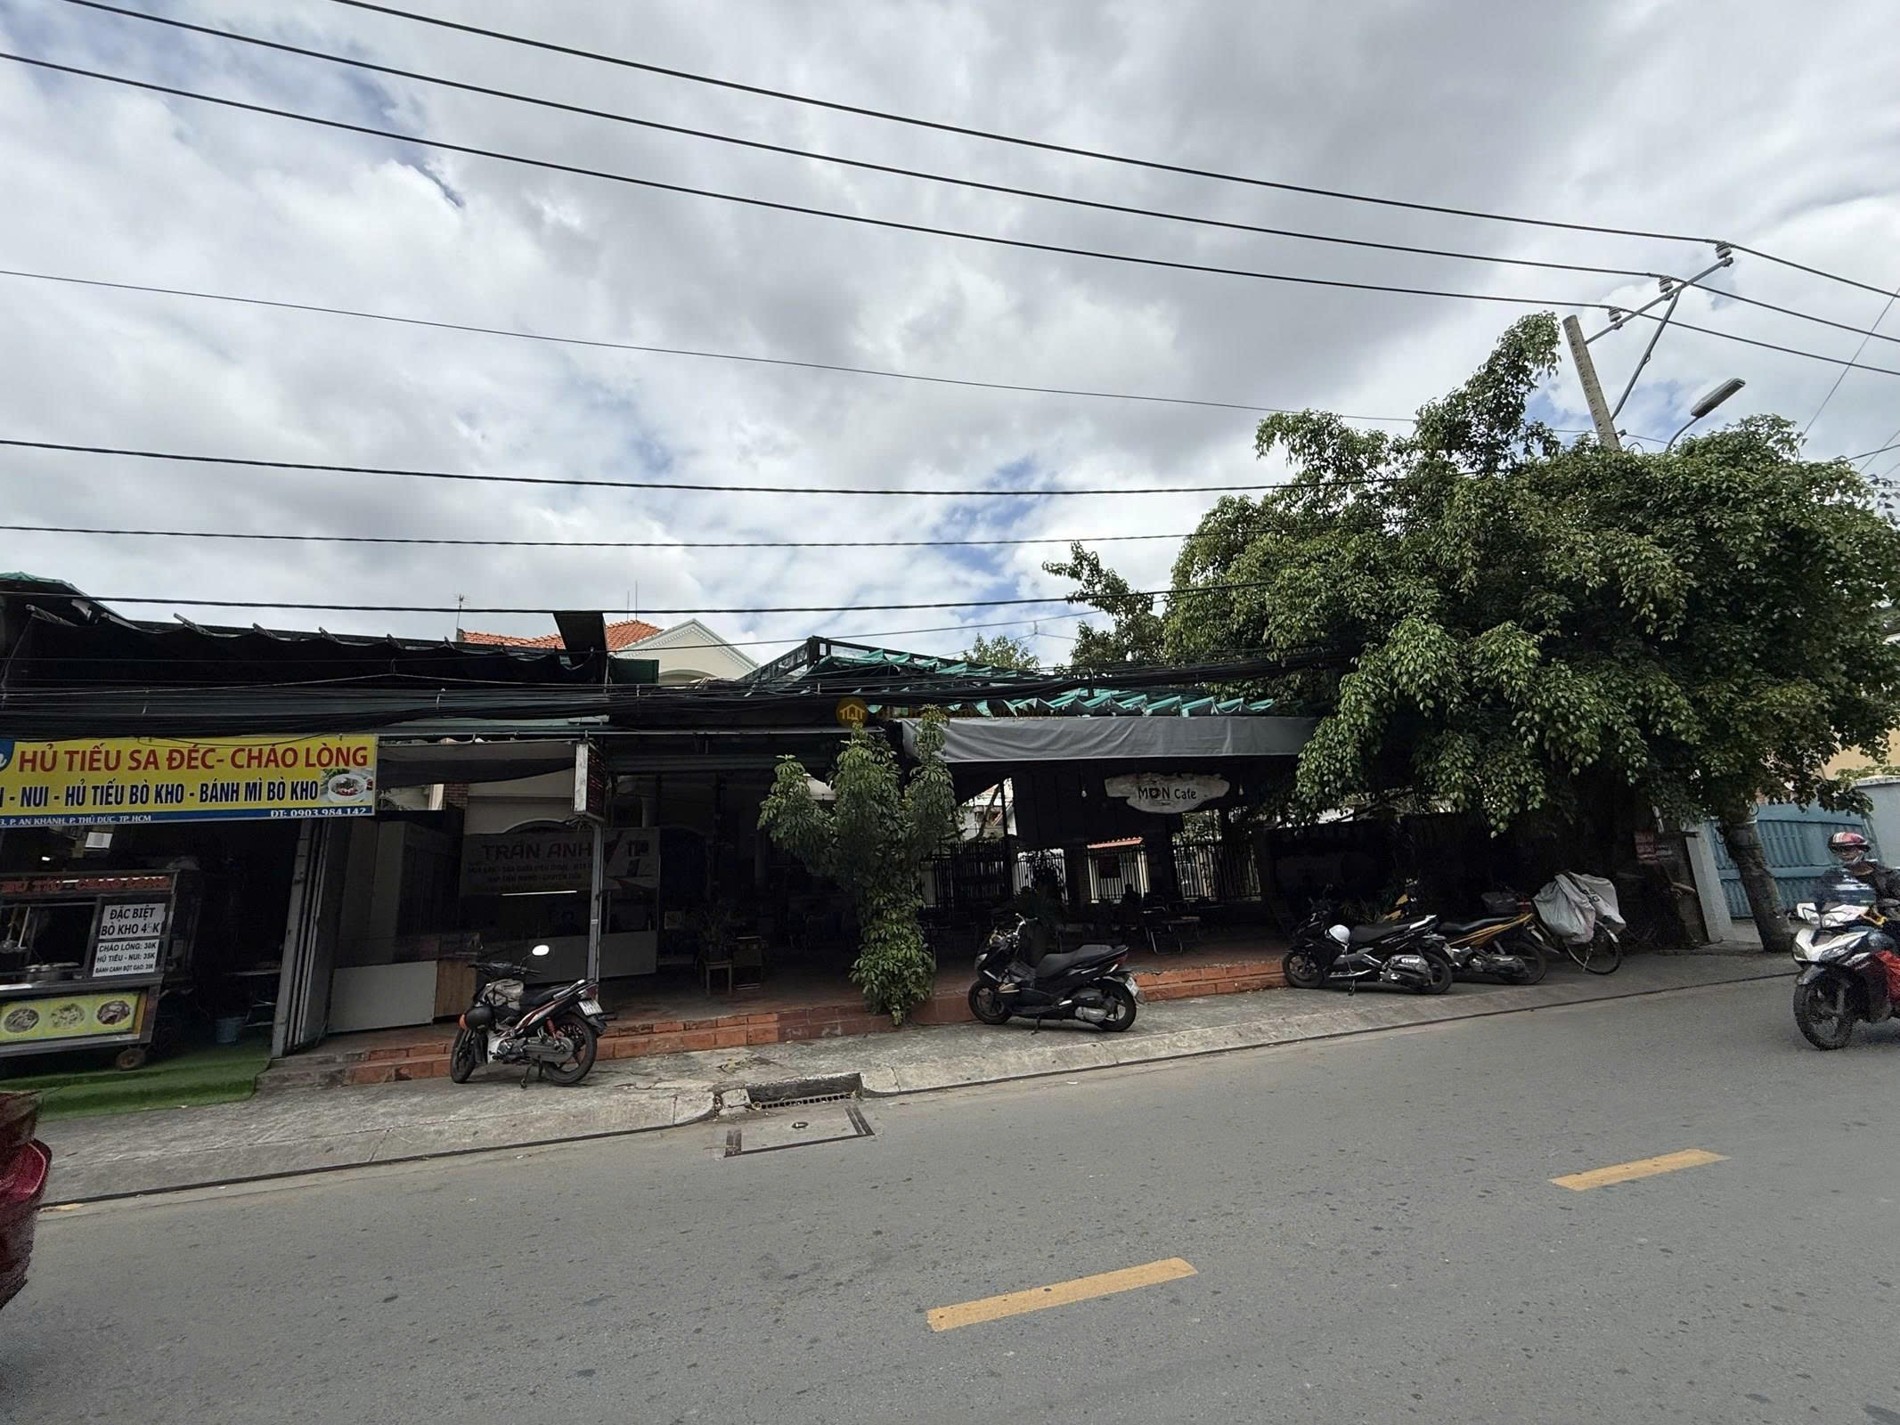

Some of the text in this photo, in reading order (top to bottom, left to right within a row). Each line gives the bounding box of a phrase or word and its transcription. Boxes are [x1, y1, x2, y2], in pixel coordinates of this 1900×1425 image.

[19, 743, 58, 772] HỦ
[64, 742, 122, 772] TIẾU
[128, 749, 160, 771] SA
[304, 742, 368, 768] LÒNG
[20, 786, 49, 807] NUI
[65, 778, 86, 806] HỦ
[92, 778, 125, 806] TIẾU
[129, 779, 150, 805] BÒ
[154, 783, 184, 804] KHO
[200, 778, 240, 803] BÁNH
[244, 778, 262, 802] MÌ
[267, 776, 286, 801] BÒ
[290, 780, 318, 801] KHO
[132, 815, 152, 823] HCM
[110, 904, 156, 922] ĐẶC BIỆT
[101, 921, 115, 936] BÒ
[117, 923, 139, 936] KHO
